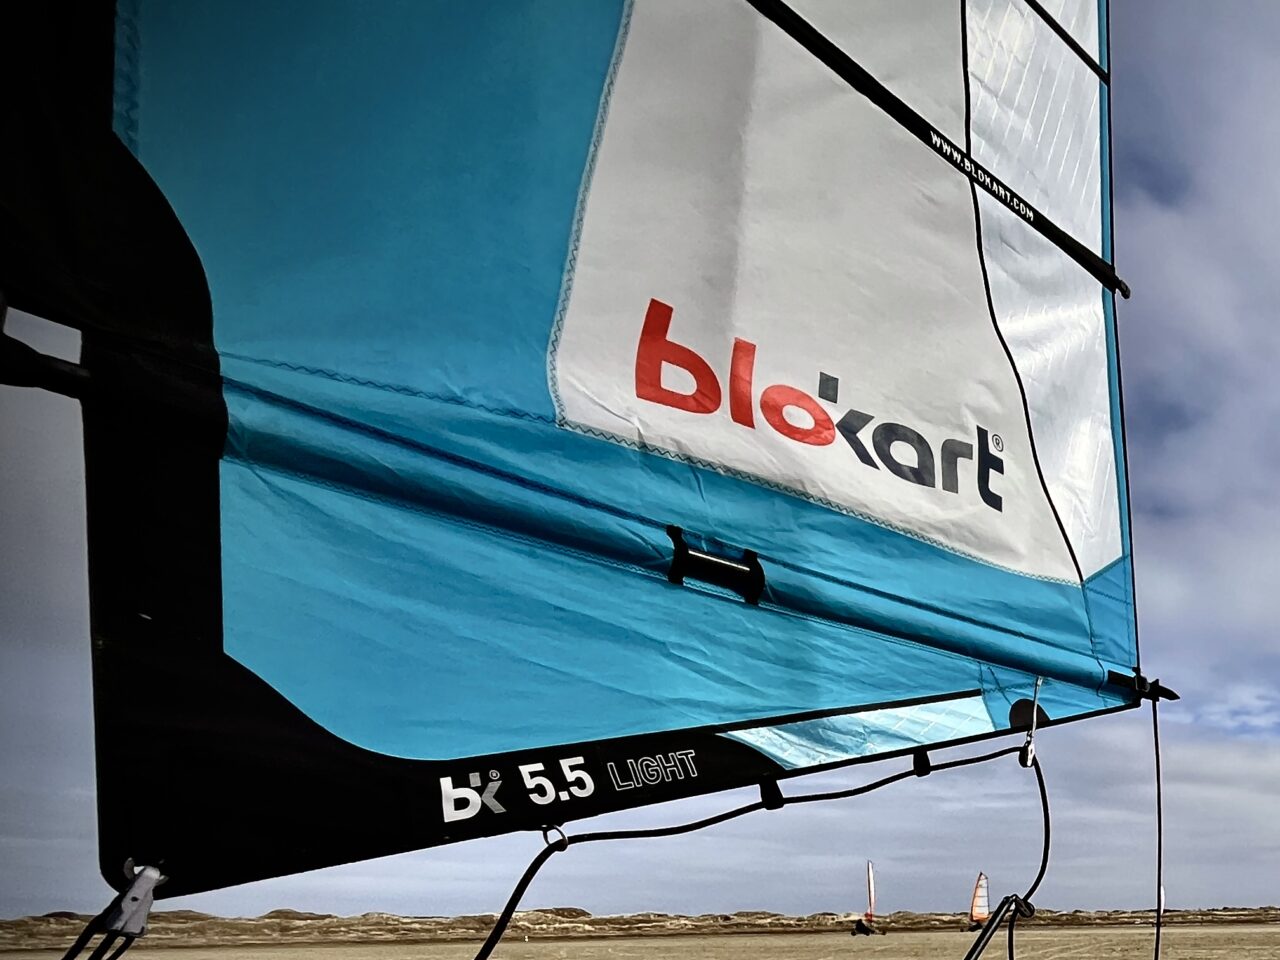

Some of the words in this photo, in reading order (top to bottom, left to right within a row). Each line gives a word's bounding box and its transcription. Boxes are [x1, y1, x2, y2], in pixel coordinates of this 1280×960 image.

[930, 130, 1034, 222] WWW.BLOKART.COM
[518, 756, 595, 805] 5.5
[607, 749, 698, 792] LIGHT
